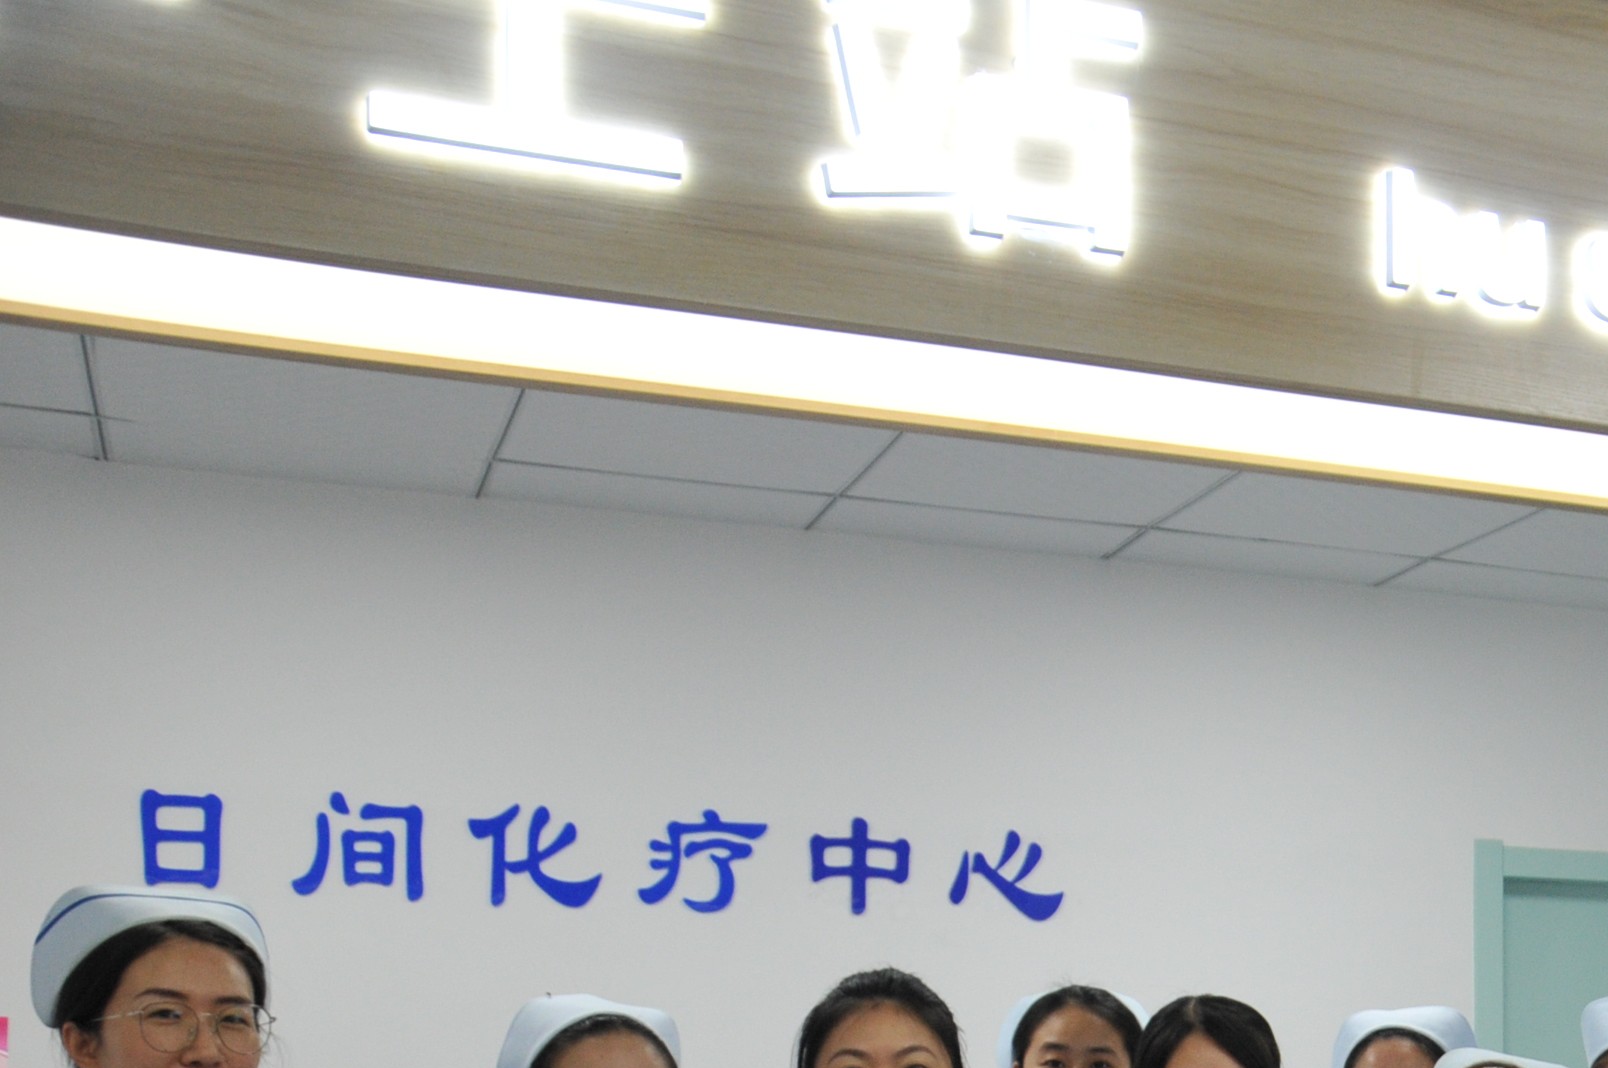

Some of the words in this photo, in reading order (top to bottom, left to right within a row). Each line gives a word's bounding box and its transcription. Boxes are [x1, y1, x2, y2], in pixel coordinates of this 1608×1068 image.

[1382, 166, 1549, 316] hu
[139, 787, 1064, 922] 日间化疗中心
